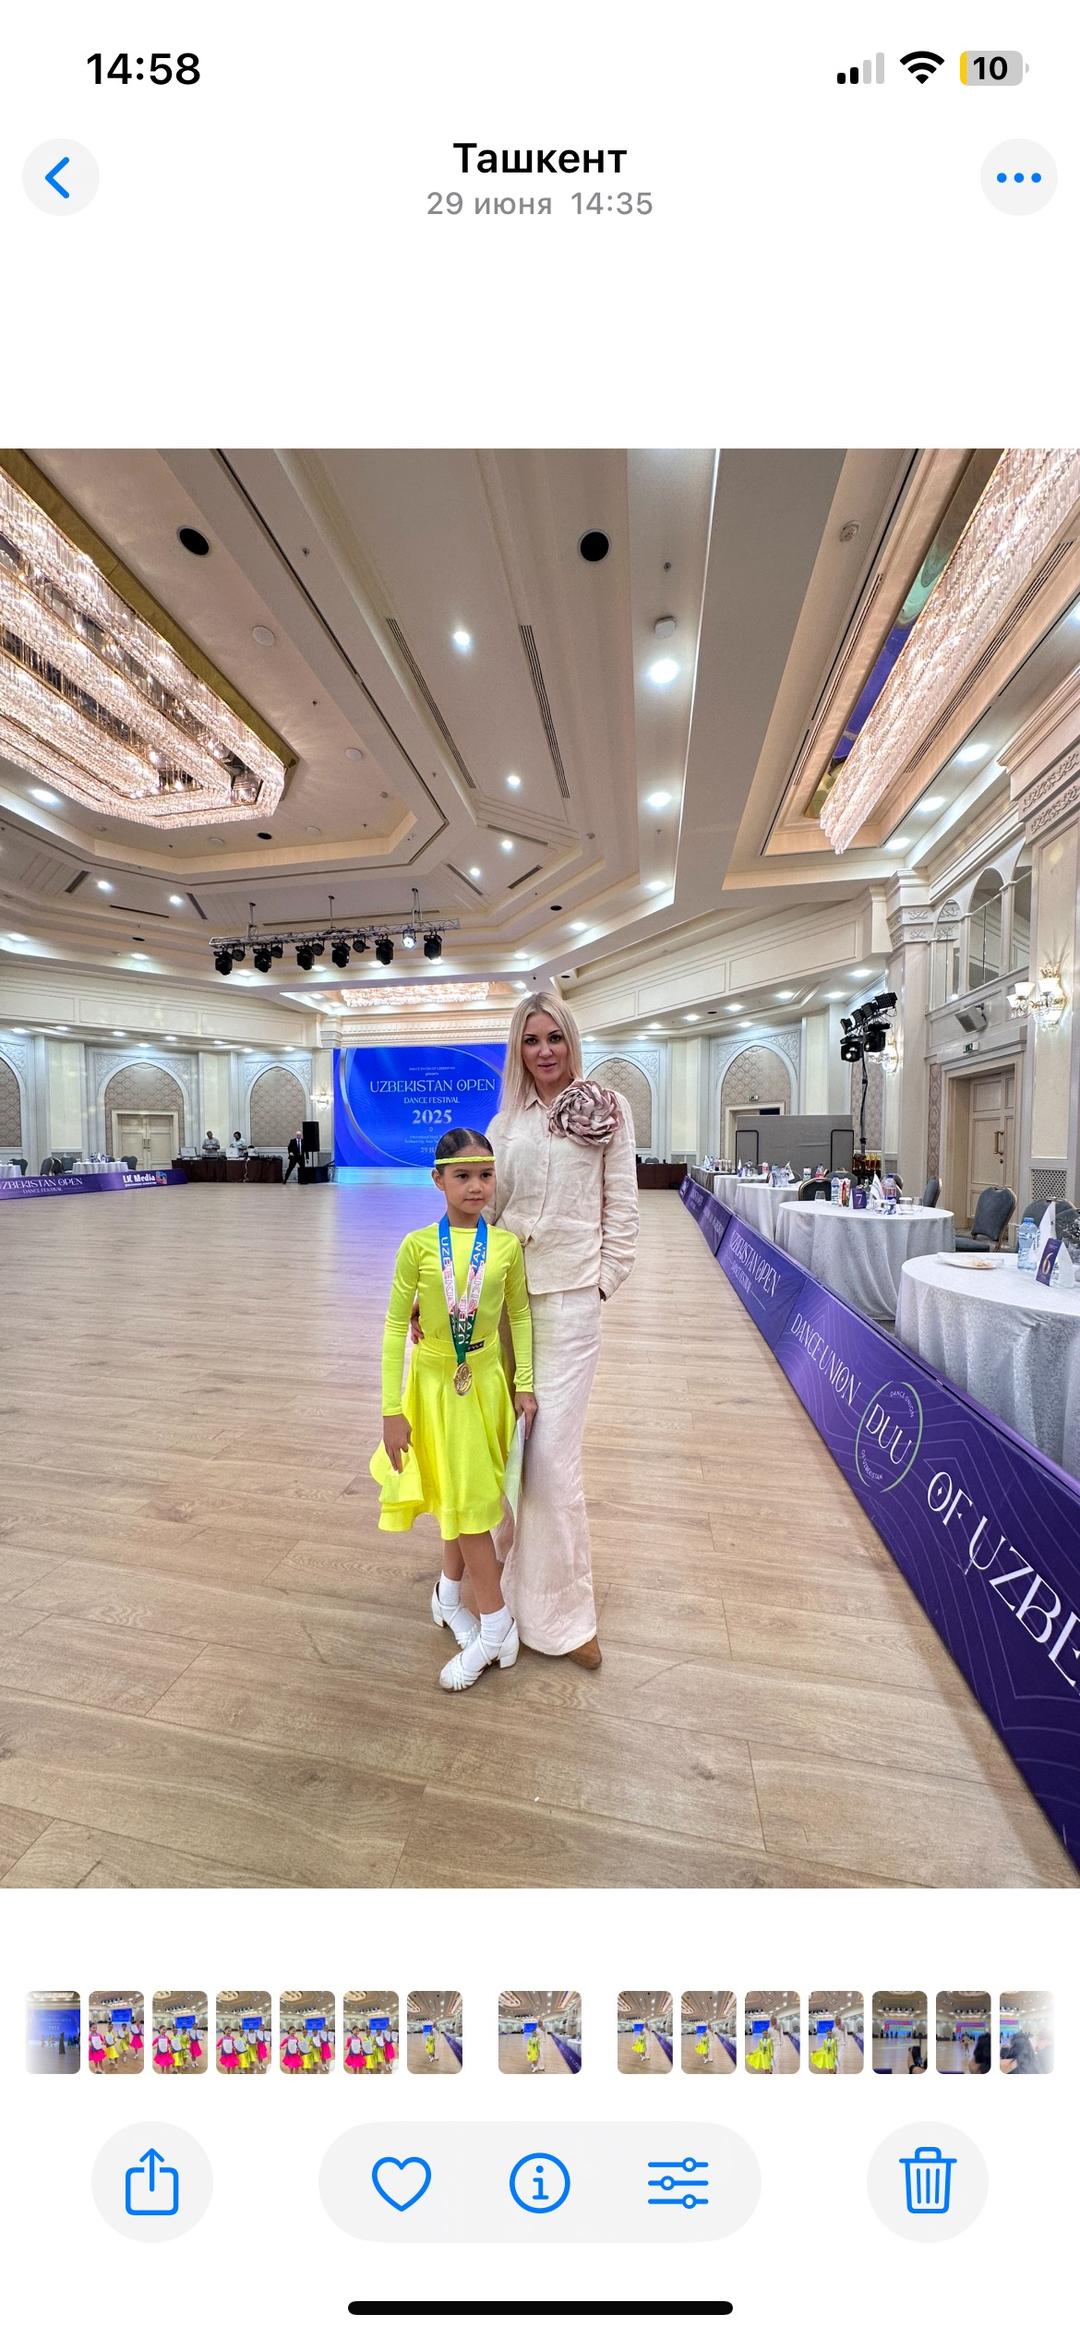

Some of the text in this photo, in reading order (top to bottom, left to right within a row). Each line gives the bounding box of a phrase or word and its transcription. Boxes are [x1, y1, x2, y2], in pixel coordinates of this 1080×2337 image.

[369, 1078, 496, 1093] UZBEKISTAN OPEN
[403, 1096, 428, 1104] DANCE
[411, 1109, 453, 1125] 2025
[0, 1179, 57, 1190] ZBEKISTAN
[855, 1193, 863, 1205] 7
[1042, 1252, 1054, 1275] 6
[754, 1259, 782, 1298] OPEN
[790, 1312, 862, 1407] DANCE UNION
[865, 1403, 913, 1465] DUU
[927, 1471, 1080, 1687] OF UZBE
